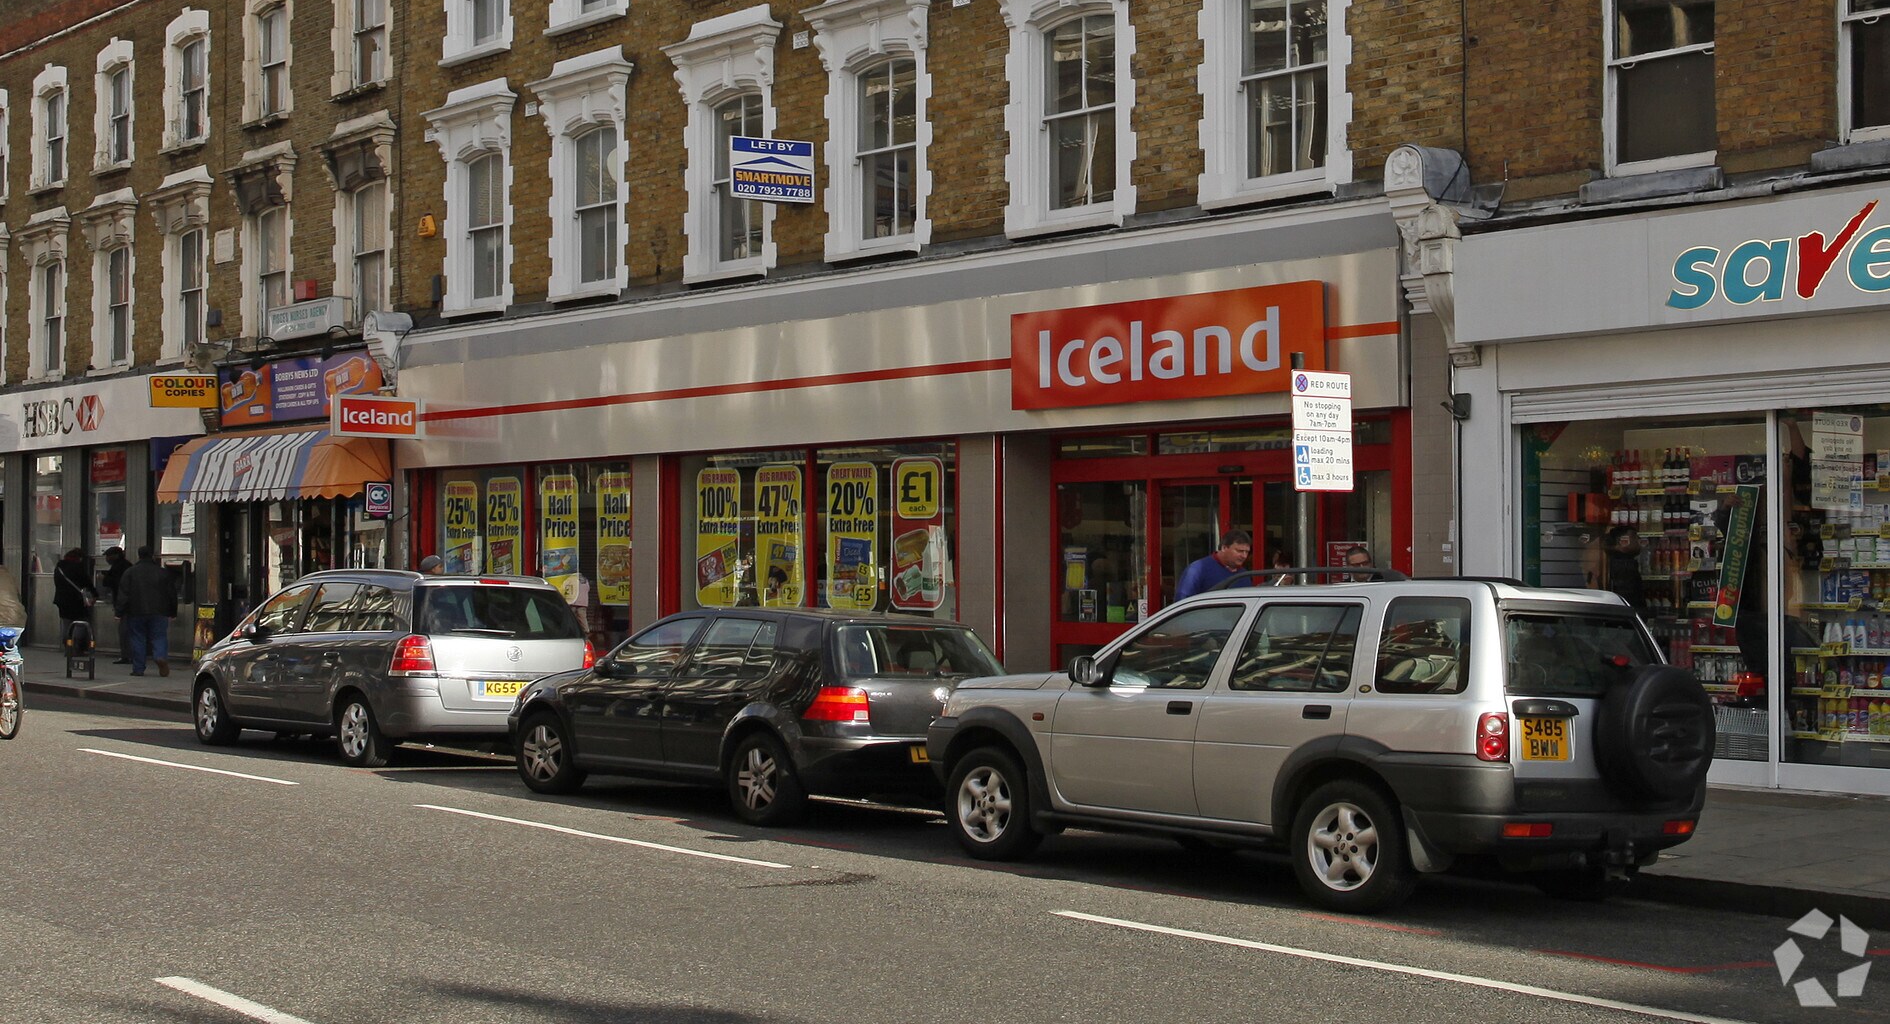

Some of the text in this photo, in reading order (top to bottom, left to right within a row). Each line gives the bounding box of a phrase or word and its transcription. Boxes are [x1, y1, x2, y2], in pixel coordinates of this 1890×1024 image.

[751, 141, 795, 151] LET BY
[735, 171, 811, 186] SMARTMOVE
[737, 183, 811, 197] 020 7923 7788
[1039, 306, 1280, 388] Iceland
[275, 368, 319, 381] BOBBYS NEWS LTD
[153, 378, 216, 389] COLOUR
[1310, 380, 1348, 390] RED ROUTE
[165, 389, 205, 397] COPIES
[1303, 401, 1341, 411] No stopping
[22, 397, 74, 439] HSBC
[343, 407, 412, 426] Iceland
[1328, 411, 1339, 420] day
[1309, 419, 1337, 428] 7am-7pm
[1296, 434, 1350, 444] Except 10am-4pm
[1311, 446, 1334, 456] loading
[1325, 456, 1335, 464] 20
[1336, 457, 1350, 465] mins
[712, 473, 736, 484] BRANDS
[760, 471, 796, 482] BIG BRANDS
[831, 467, 872, 479] GREAT VALUE
[1326, 473, 1331, 481] 3
[1332, 473, 1349, 481] hours
[901, 471, 931, 502] £1
[700, 486, 737, 518] 100%
[759, 484, 798, 517] 47%
[831, 481, 874, 515] 20%
[447, 497, 475, 525] 25%
[488, 494, 519, 522] 25%
[549, 495, 572, 515] Half
[909, 504, 926, 512] each
[446, 526, 460, 538] Extra
[488, 524, 519, 536] Extra Free
[545, 517, 576, 537] Price
[600, 517, 630, 537] Price
[700, 520, 737, 533] Extra Free
[758, 520, 779, 533] Extra
[830, 518, 874, 533] Extra Free
[1723, 550, 1743, 601] Festive
[855, 588, 871, 601] £5
[486, 683, 516, 693] KG55
[1524, 719, 1562, 736] S485
[1530, 739, 1558, 756] BWW
